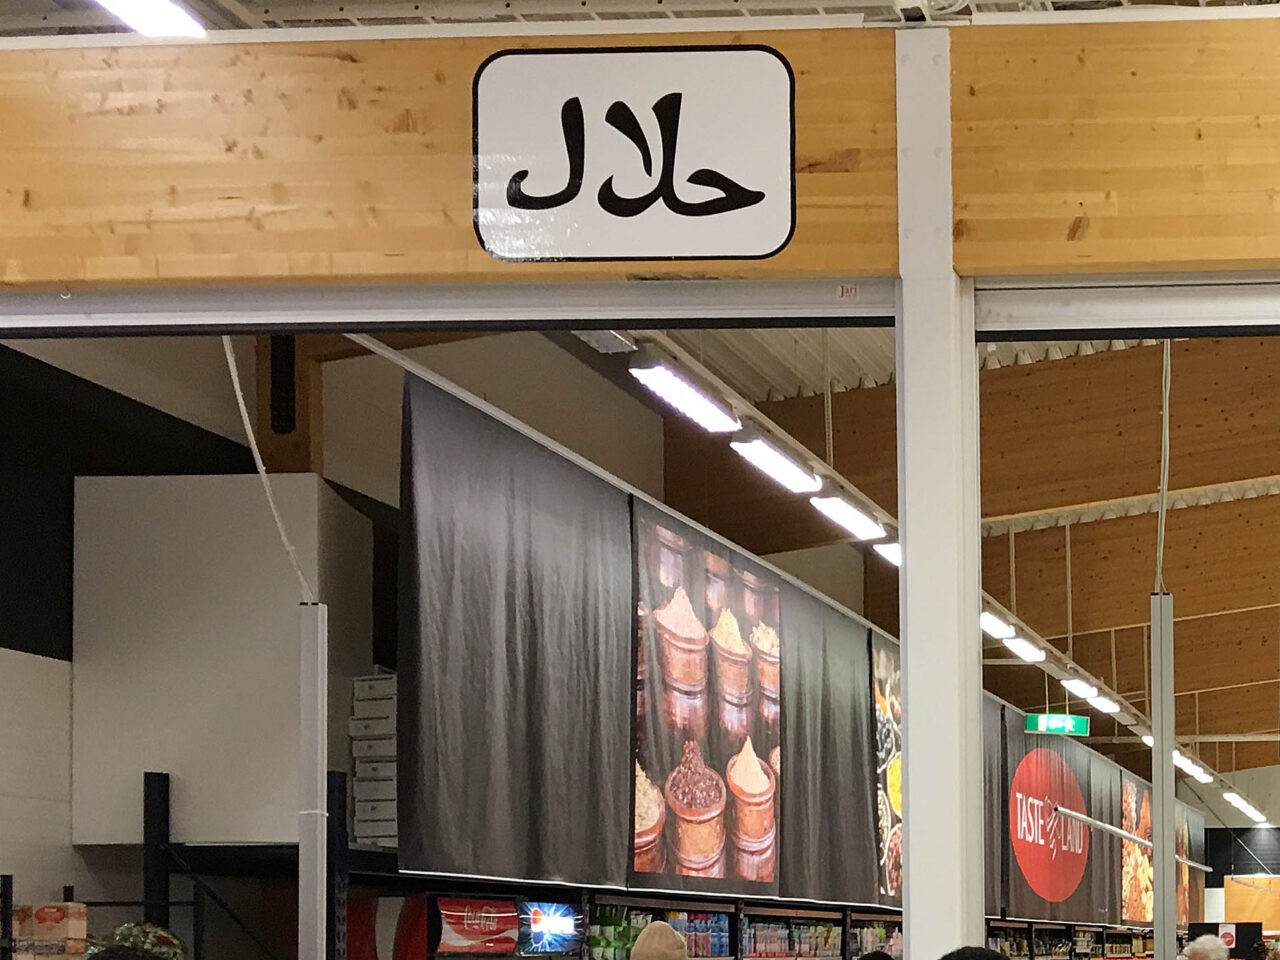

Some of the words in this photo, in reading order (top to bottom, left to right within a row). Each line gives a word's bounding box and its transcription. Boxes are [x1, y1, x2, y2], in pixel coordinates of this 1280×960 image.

[506, 92, 766, 218] حلال
[1015, 792, 1045, 846] TASTE
[1061, 812, 1084, 855] LAND
